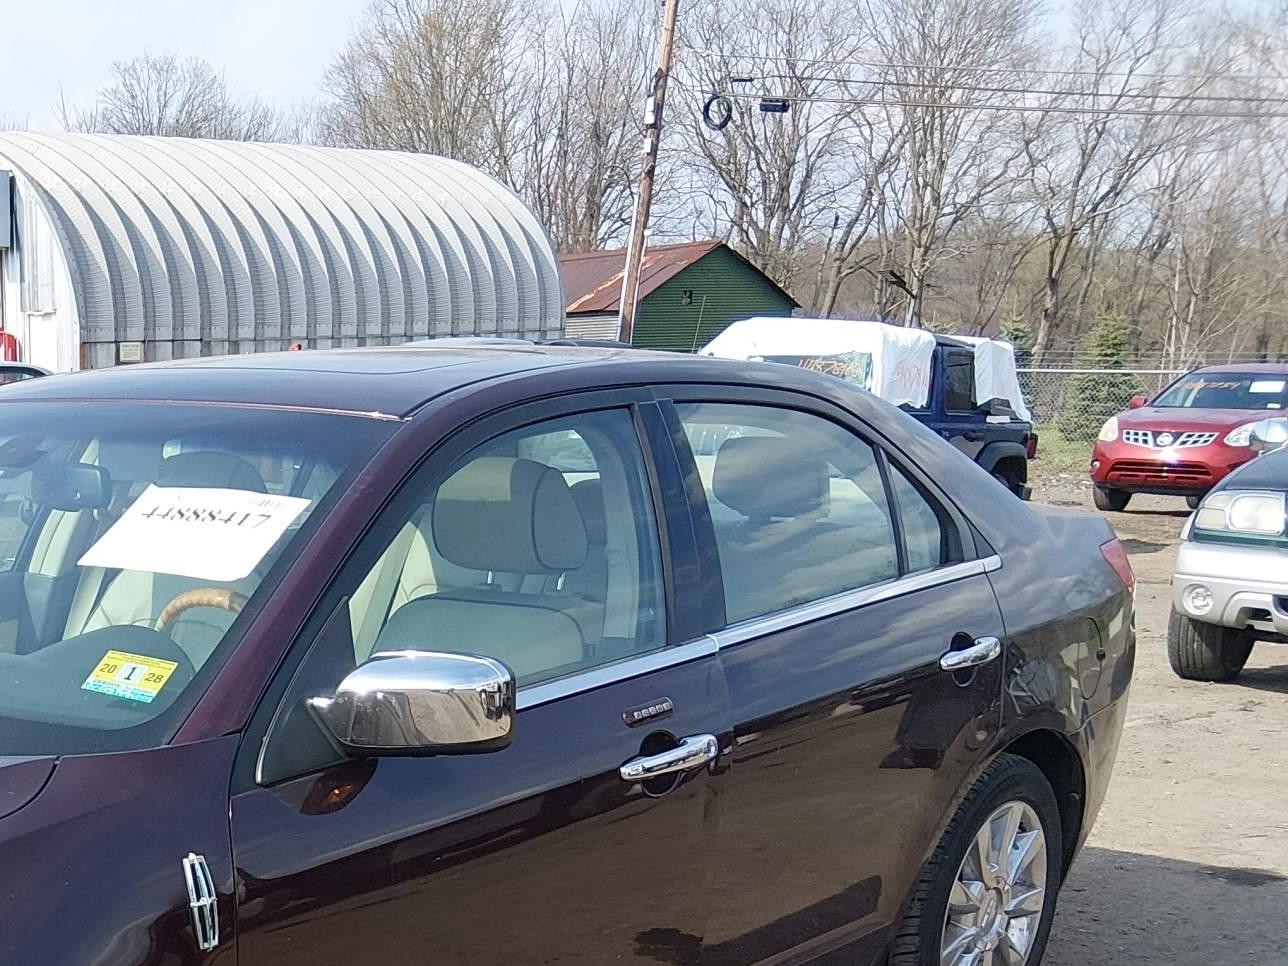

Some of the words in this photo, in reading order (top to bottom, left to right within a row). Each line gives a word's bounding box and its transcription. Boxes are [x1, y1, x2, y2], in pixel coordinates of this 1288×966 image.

[142, 506, 272, 528] 44888417
[99, 663, 118, 674] 20
[123, 666, 137, 681] 1
